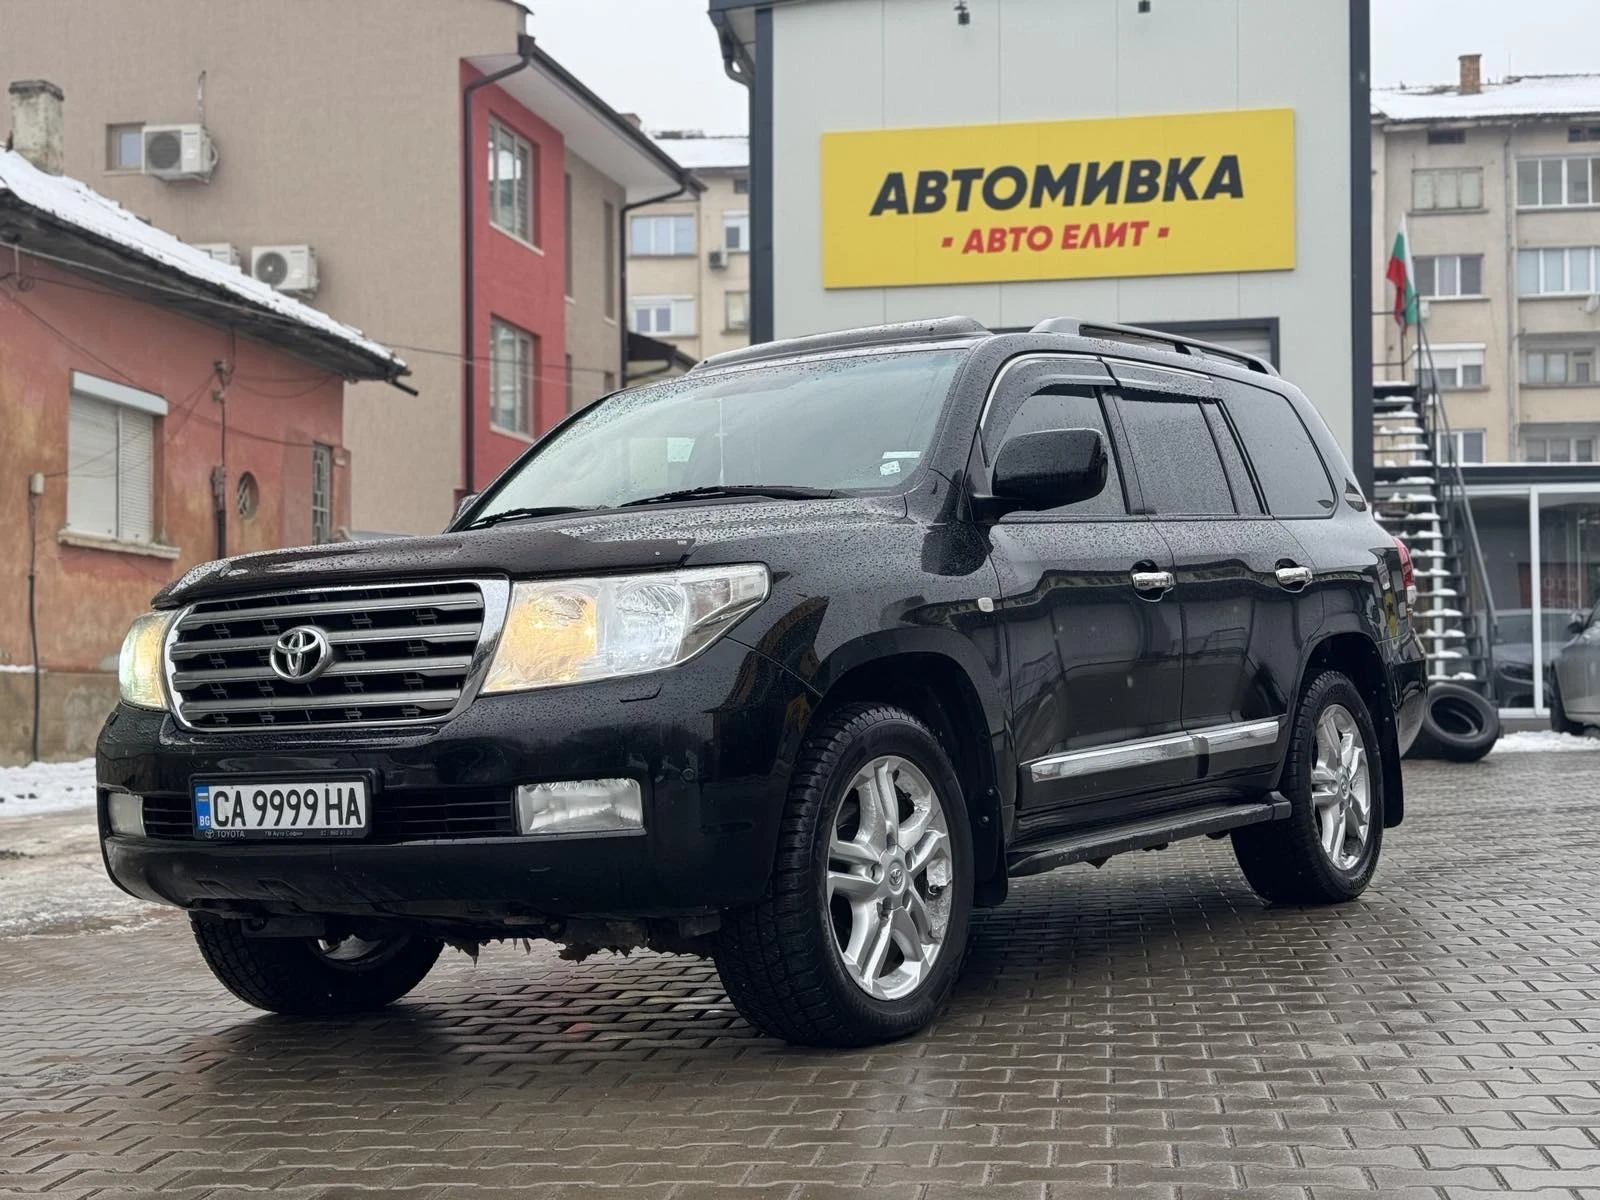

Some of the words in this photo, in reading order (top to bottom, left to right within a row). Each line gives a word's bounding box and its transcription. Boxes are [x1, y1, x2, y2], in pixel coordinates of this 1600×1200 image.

[869, 154, 1244, 217] АВТОМИВКА
[962, 225, 1053, 255] АВТО
[1060, 220, 1150, 250] ЕЛИТ
[200, 816, 210, 827] BG
[213, 790, 246, 827] CA
[252, 789, 319, 827] 9999
[324, 787, 362, 826] HA
[217, 830, 245, 838] TOYOTA
